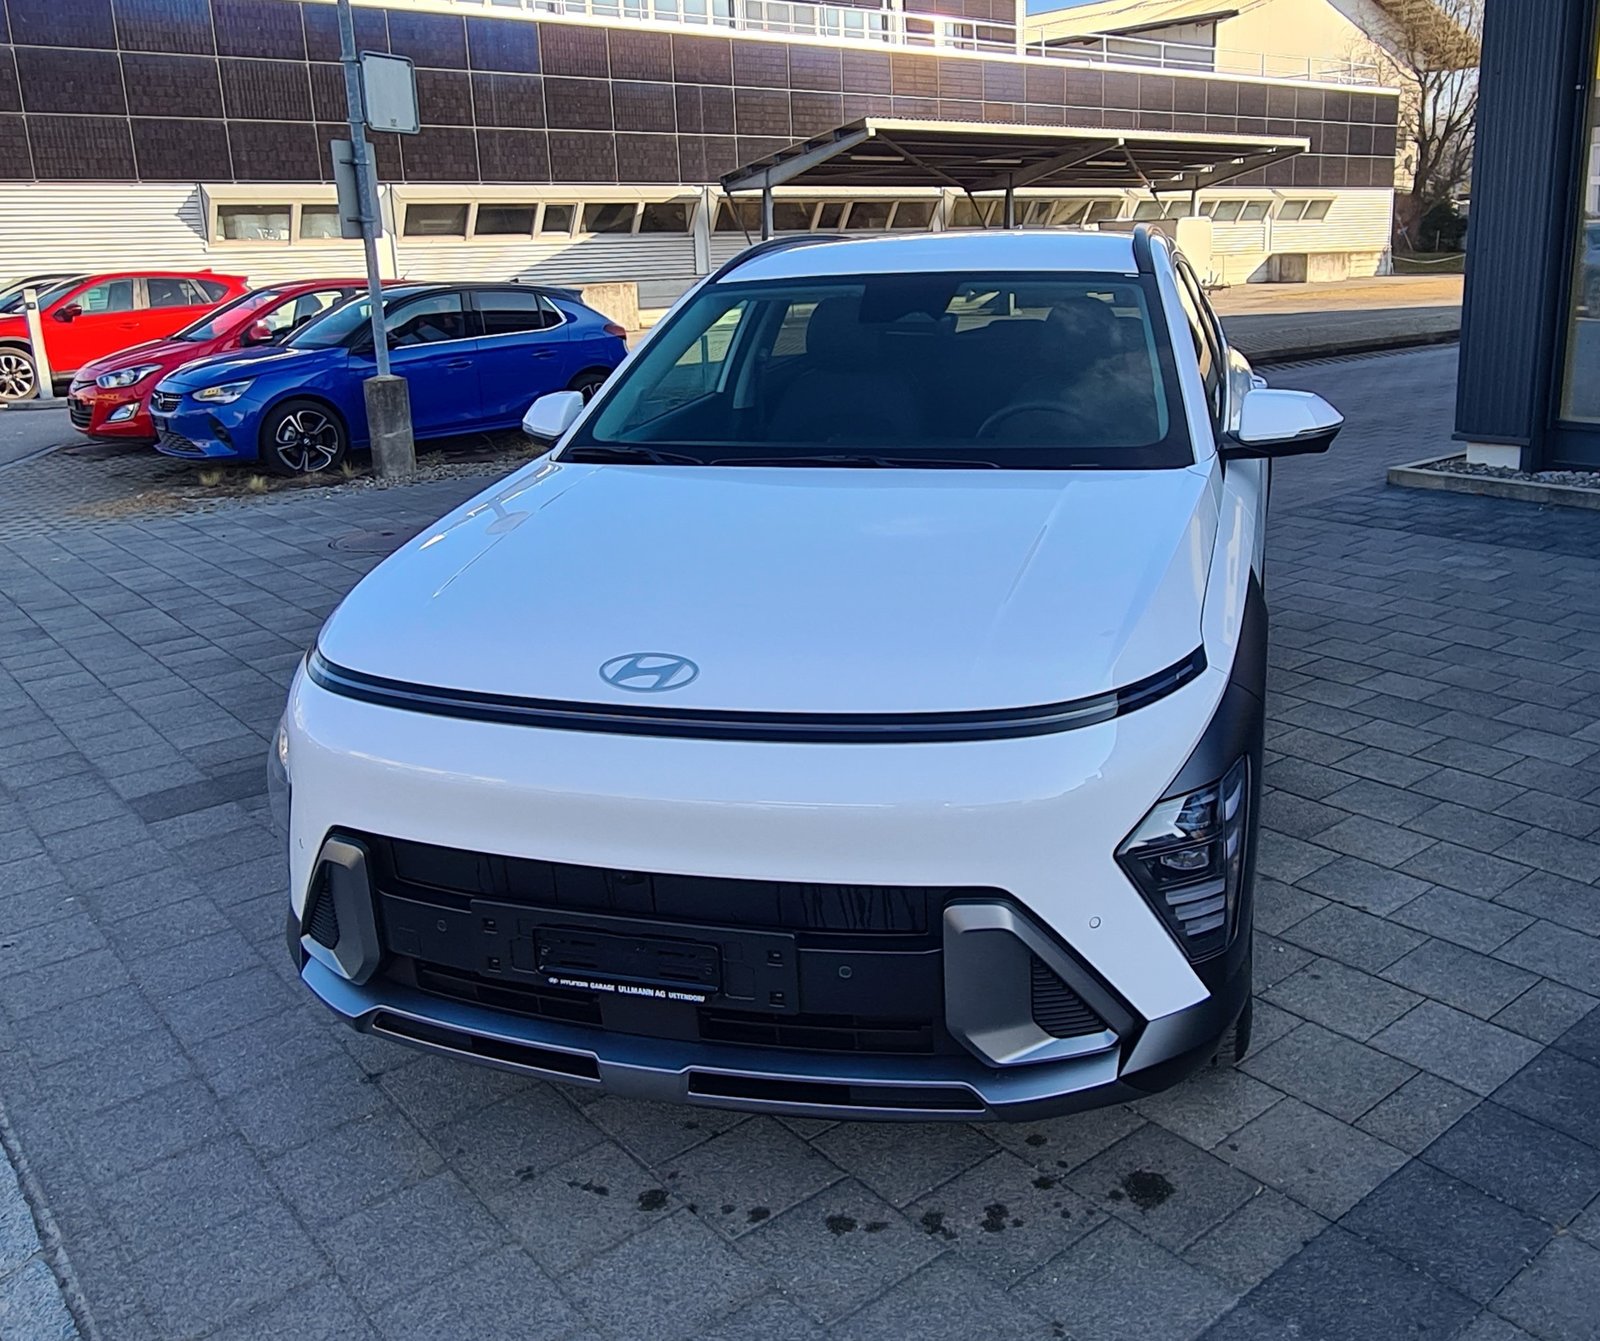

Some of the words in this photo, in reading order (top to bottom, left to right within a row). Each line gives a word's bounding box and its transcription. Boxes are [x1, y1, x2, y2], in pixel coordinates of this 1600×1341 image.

[590, 982, 615, 991] GARAGE
[618, 985, 654, 997] ULLMANN
[655, 989, 666, 998] AG
